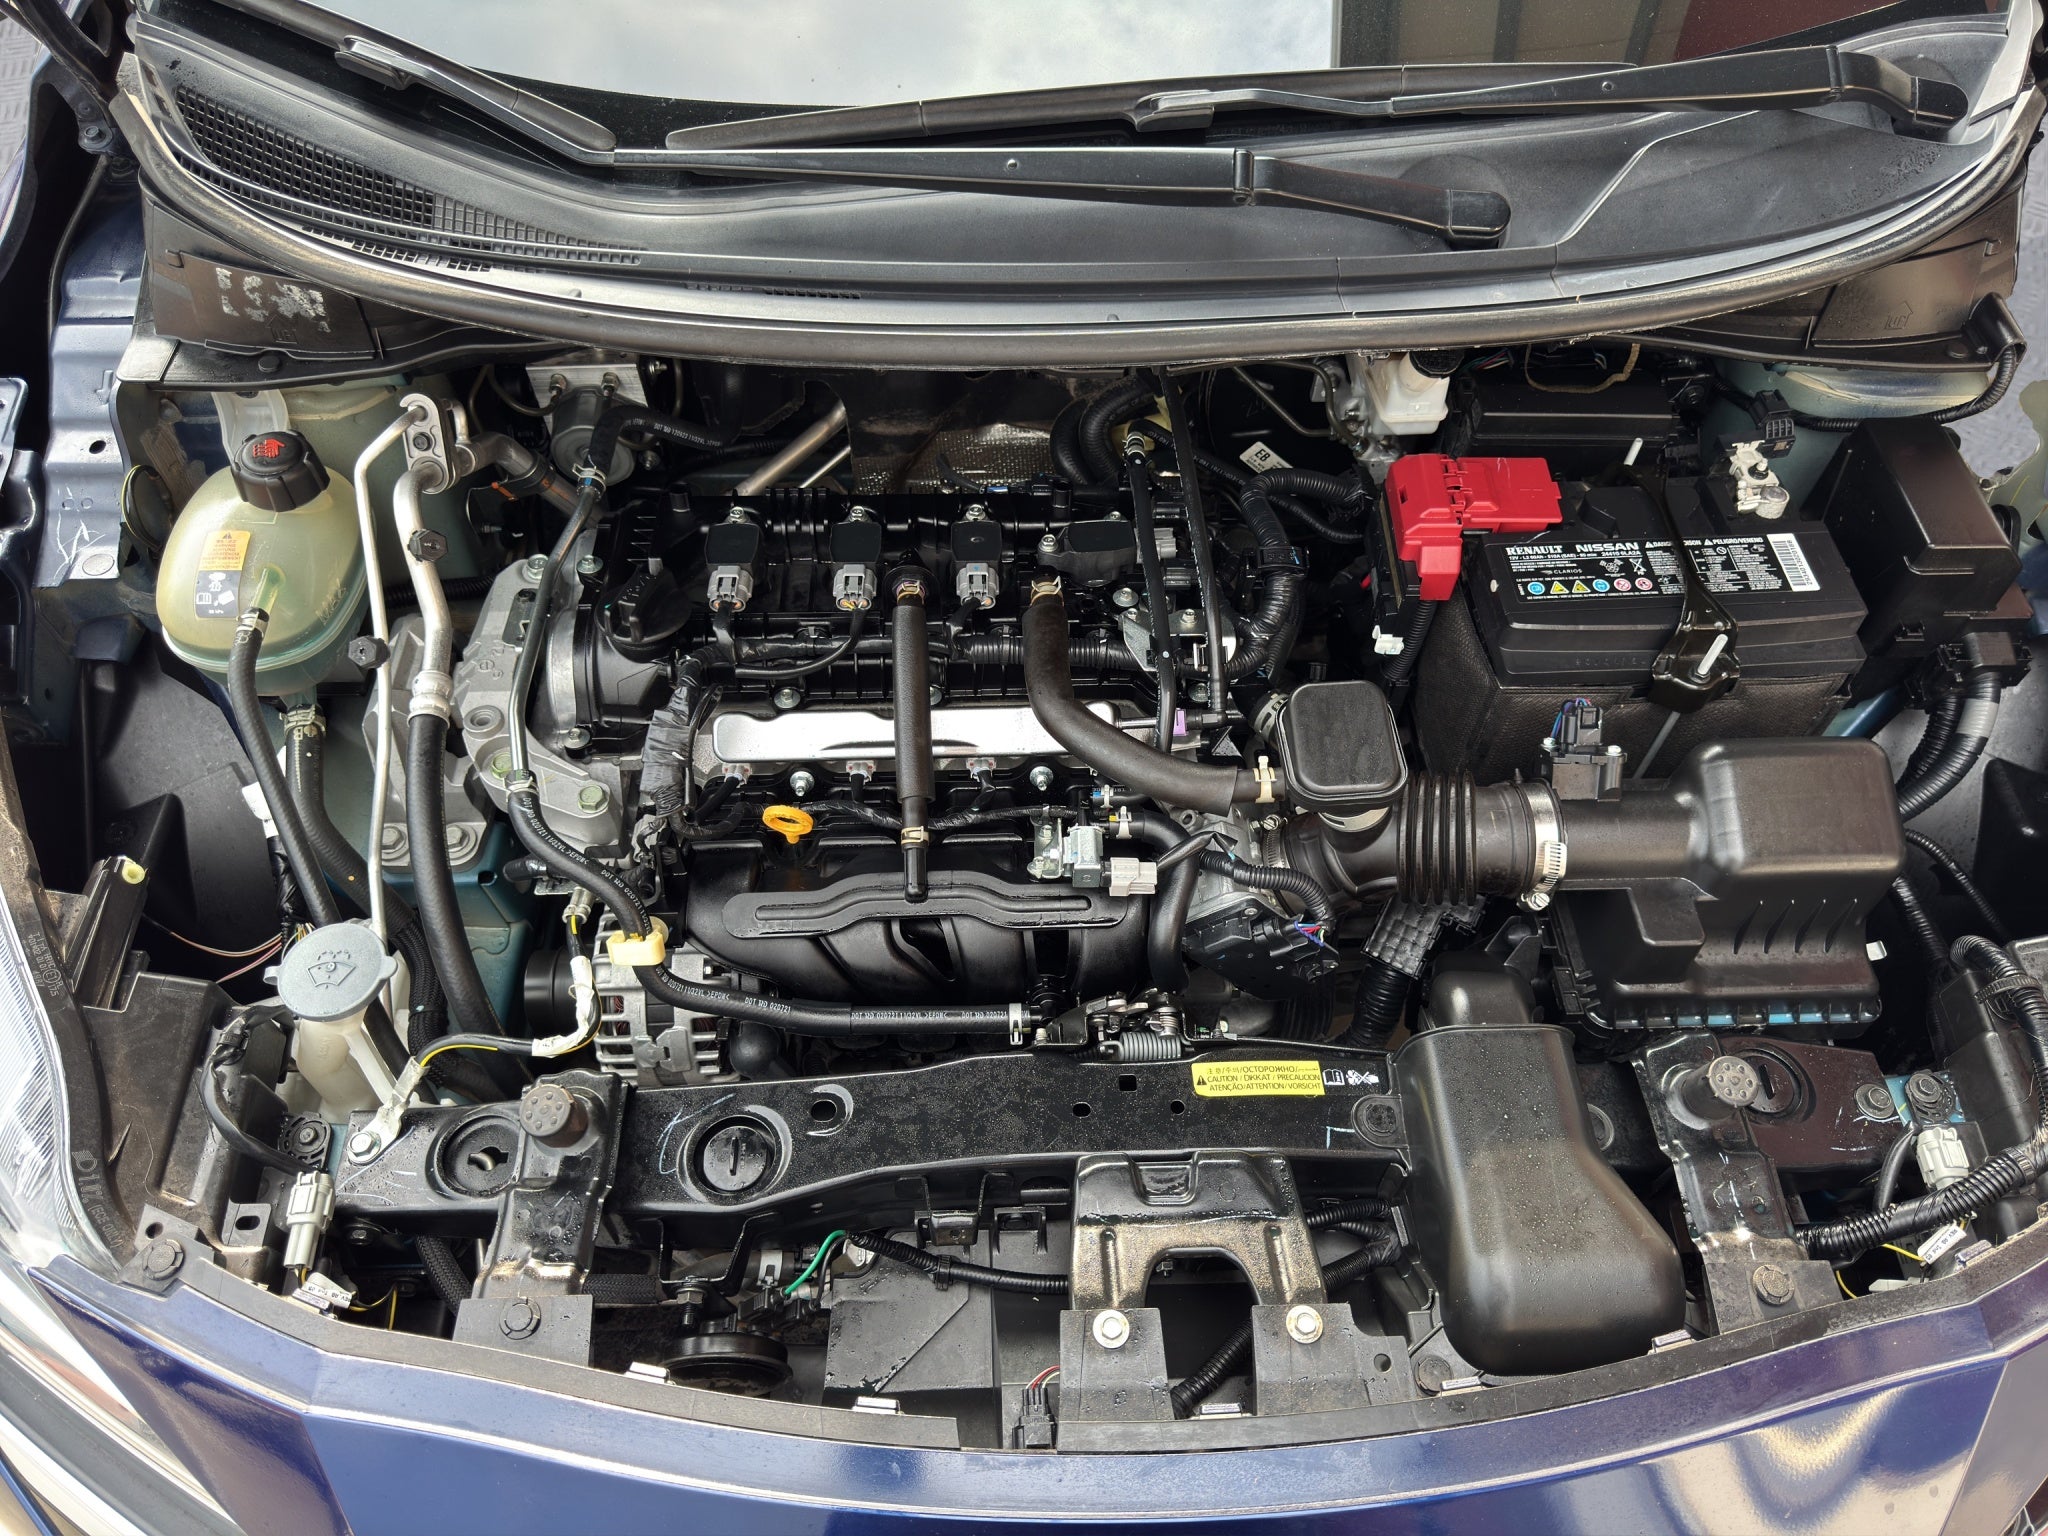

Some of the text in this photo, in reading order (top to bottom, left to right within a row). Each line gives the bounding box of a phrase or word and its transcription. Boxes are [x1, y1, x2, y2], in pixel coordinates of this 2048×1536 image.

[1255, 449, 1270, 463] EB
[1506, 542, 1639, 556] RENAULT NISSAN
[530, 819, 547, 838] 020721
[601, 869, 614, 880] DOT
[624, 887, 642, 911] 020721
[744, 997, 756, 1006] DOT
[769, 1002, 791, 1013] 020721
